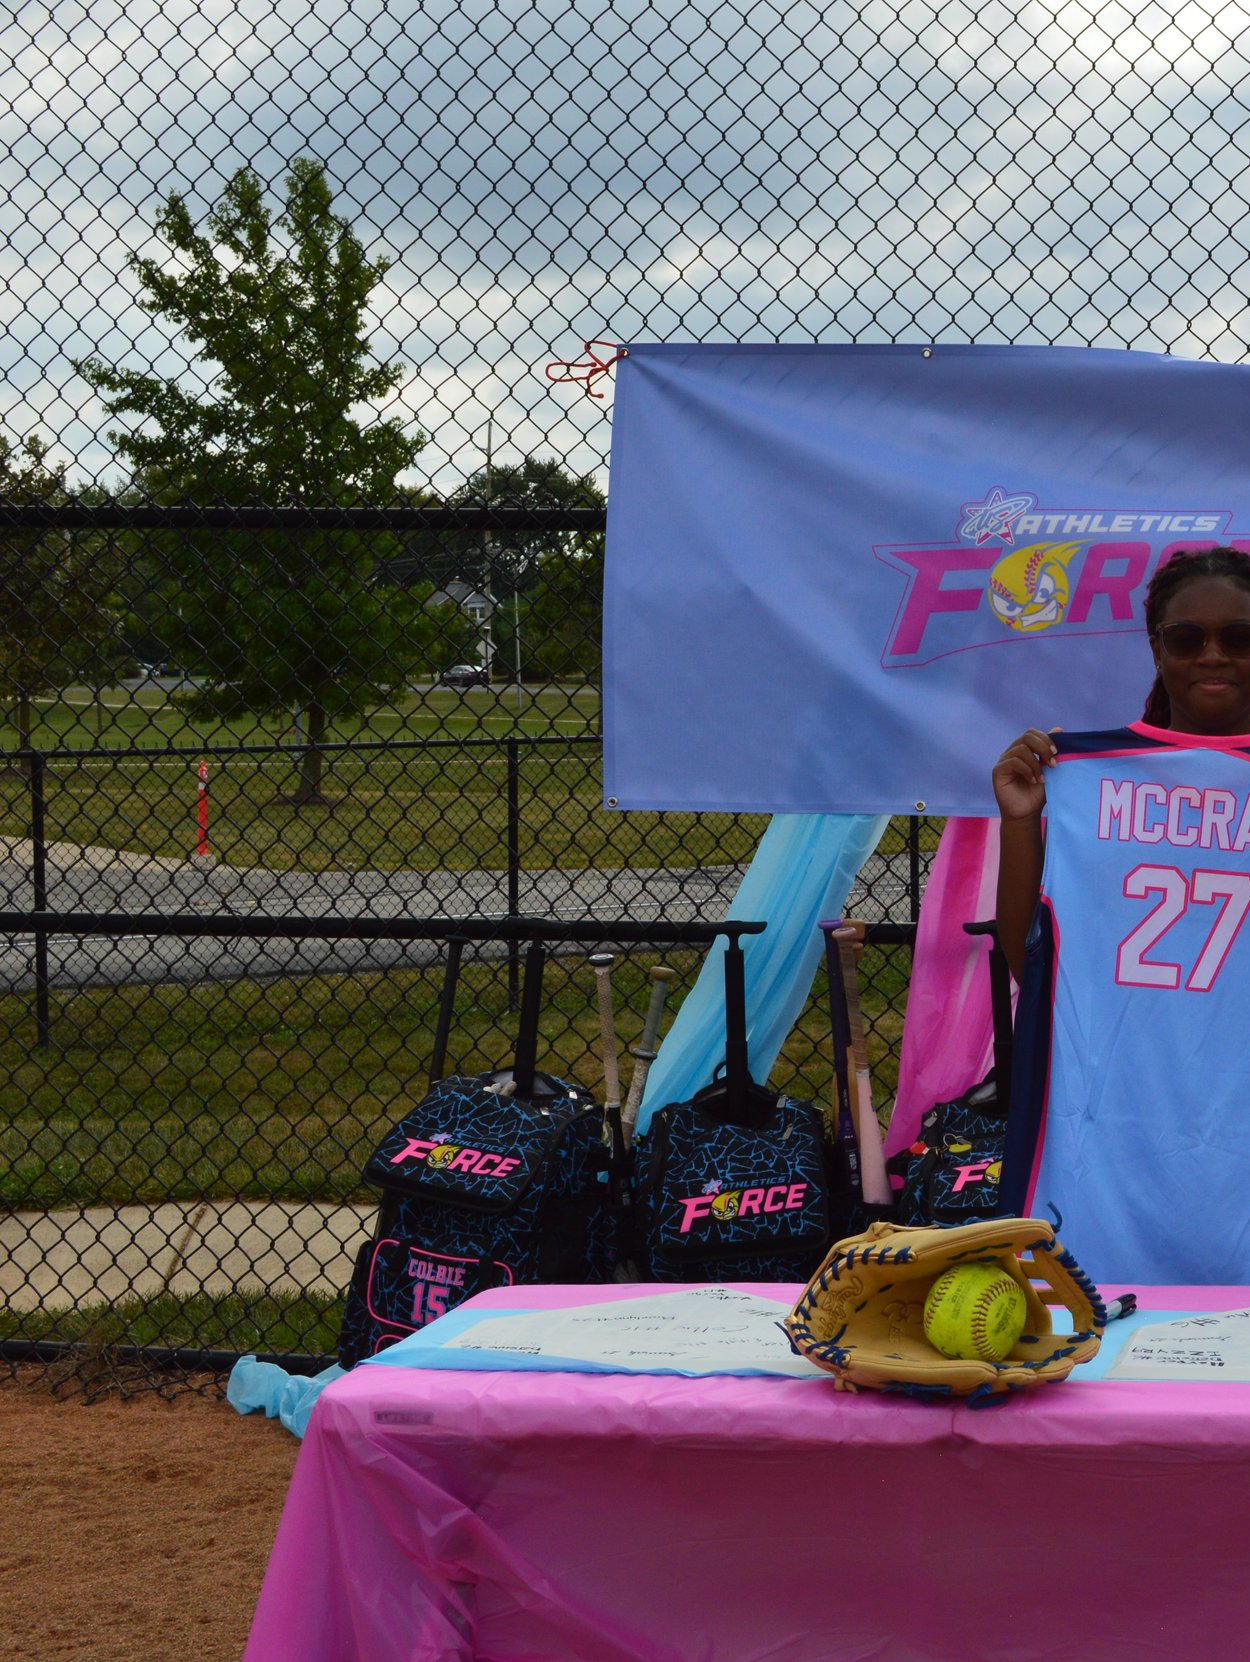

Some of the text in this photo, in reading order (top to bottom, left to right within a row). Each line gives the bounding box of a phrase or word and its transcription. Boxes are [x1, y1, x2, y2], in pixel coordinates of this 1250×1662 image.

[1015, 514, 1222, 536] ATHLETICS
[719, 1175, 787, 1191] ATHLETICS
[408, 1258, 467, 1287] COLBIE
[411, 1283, 450, 1324] 15
[818, 1275, 866, 1341] Rawlings
